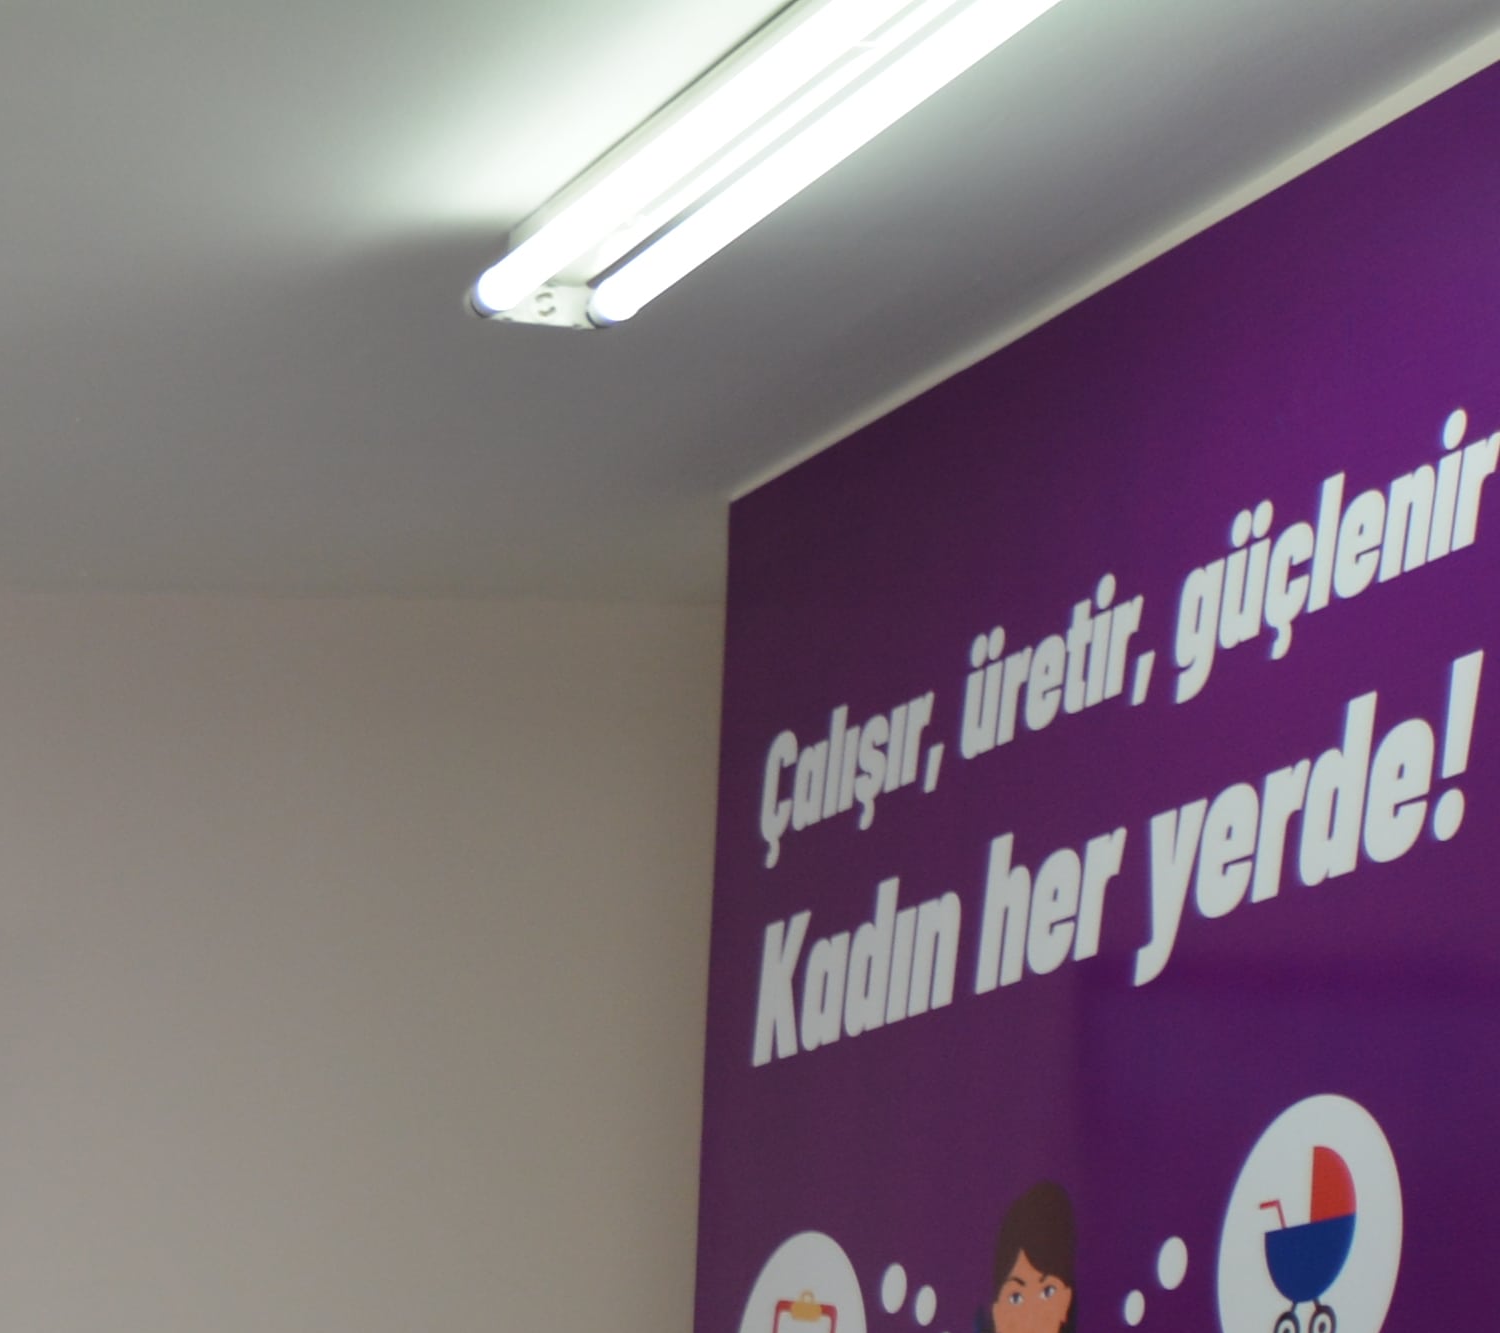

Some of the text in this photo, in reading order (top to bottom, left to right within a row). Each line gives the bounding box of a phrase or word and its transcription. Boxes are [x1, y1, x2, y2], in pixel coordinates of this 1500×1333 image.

[760, 408, 1500, 868] Çalışır, üretir, güçlenir
[752, 650, 1483, 1067] Kadın her yerde!
